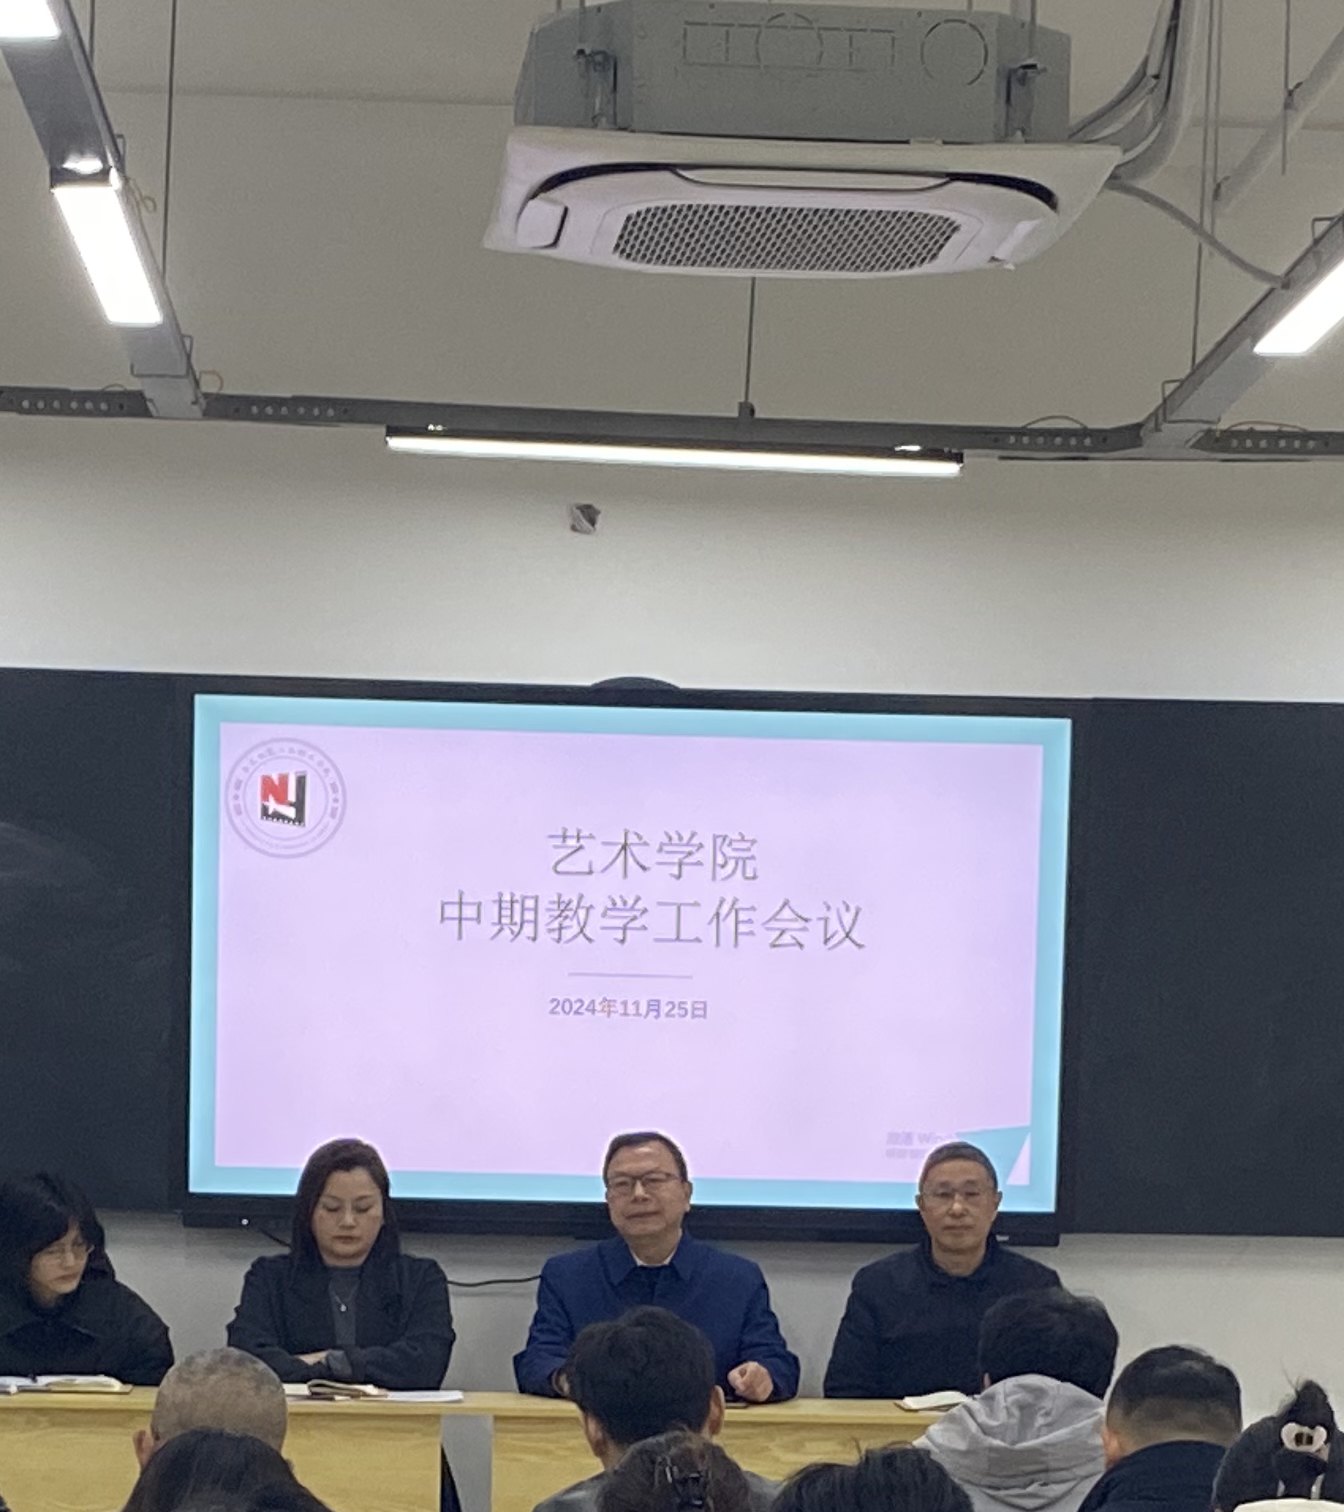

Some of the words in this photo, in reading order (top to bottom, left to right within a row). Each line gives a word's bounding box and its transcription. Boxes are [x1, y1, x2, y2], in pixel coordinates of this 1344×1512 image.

[547, 827, 758, 881] 艺术学院
[439, 890, 866, 950] 中期教学工作会议
[548, 997, 708, 1020] 2024年11月25日
